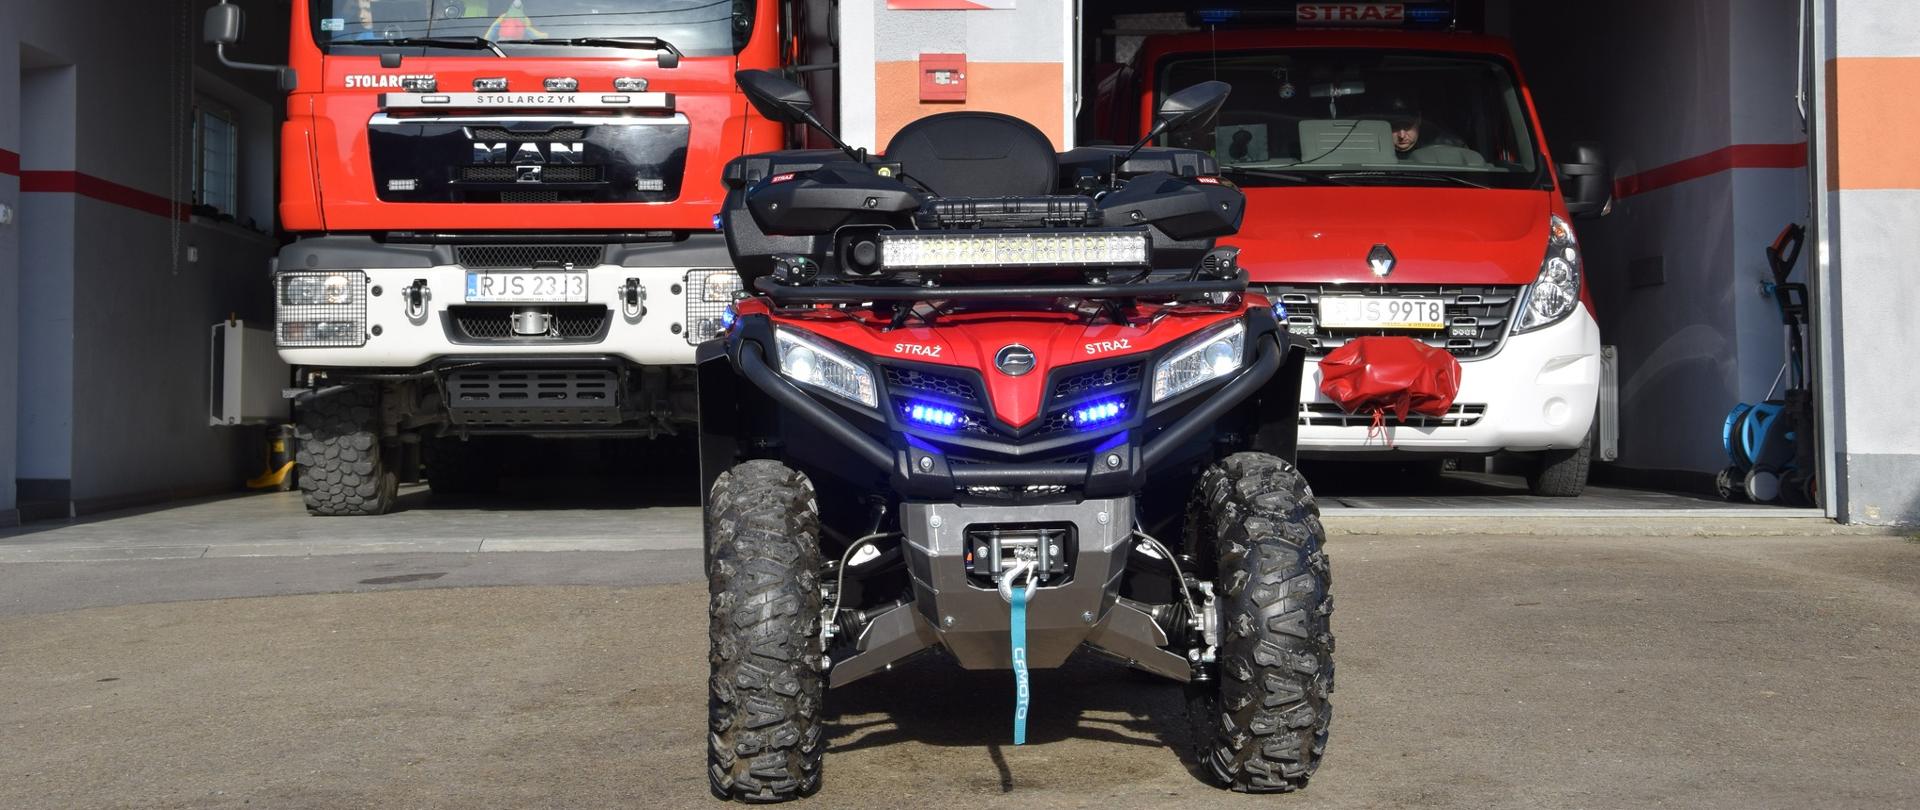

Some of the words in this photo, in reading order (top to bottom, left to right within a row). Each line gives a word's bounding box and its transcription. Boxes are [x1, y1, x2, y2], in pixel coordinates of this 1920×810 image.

[477, 95, 576, 104] STOLARCZYK
[473, 142, 584, 164] MAN
[480, 276, 525, 296] RJS
[1335, 301, 1381, 321] JS
[1388, 301, 1440, 321] 99T8
[894, 343, 942, 358] STRAŻ
[1085, 338, 1132, 354] STRAŻ
[1014, 647, 1028, 719] CFMOTO
